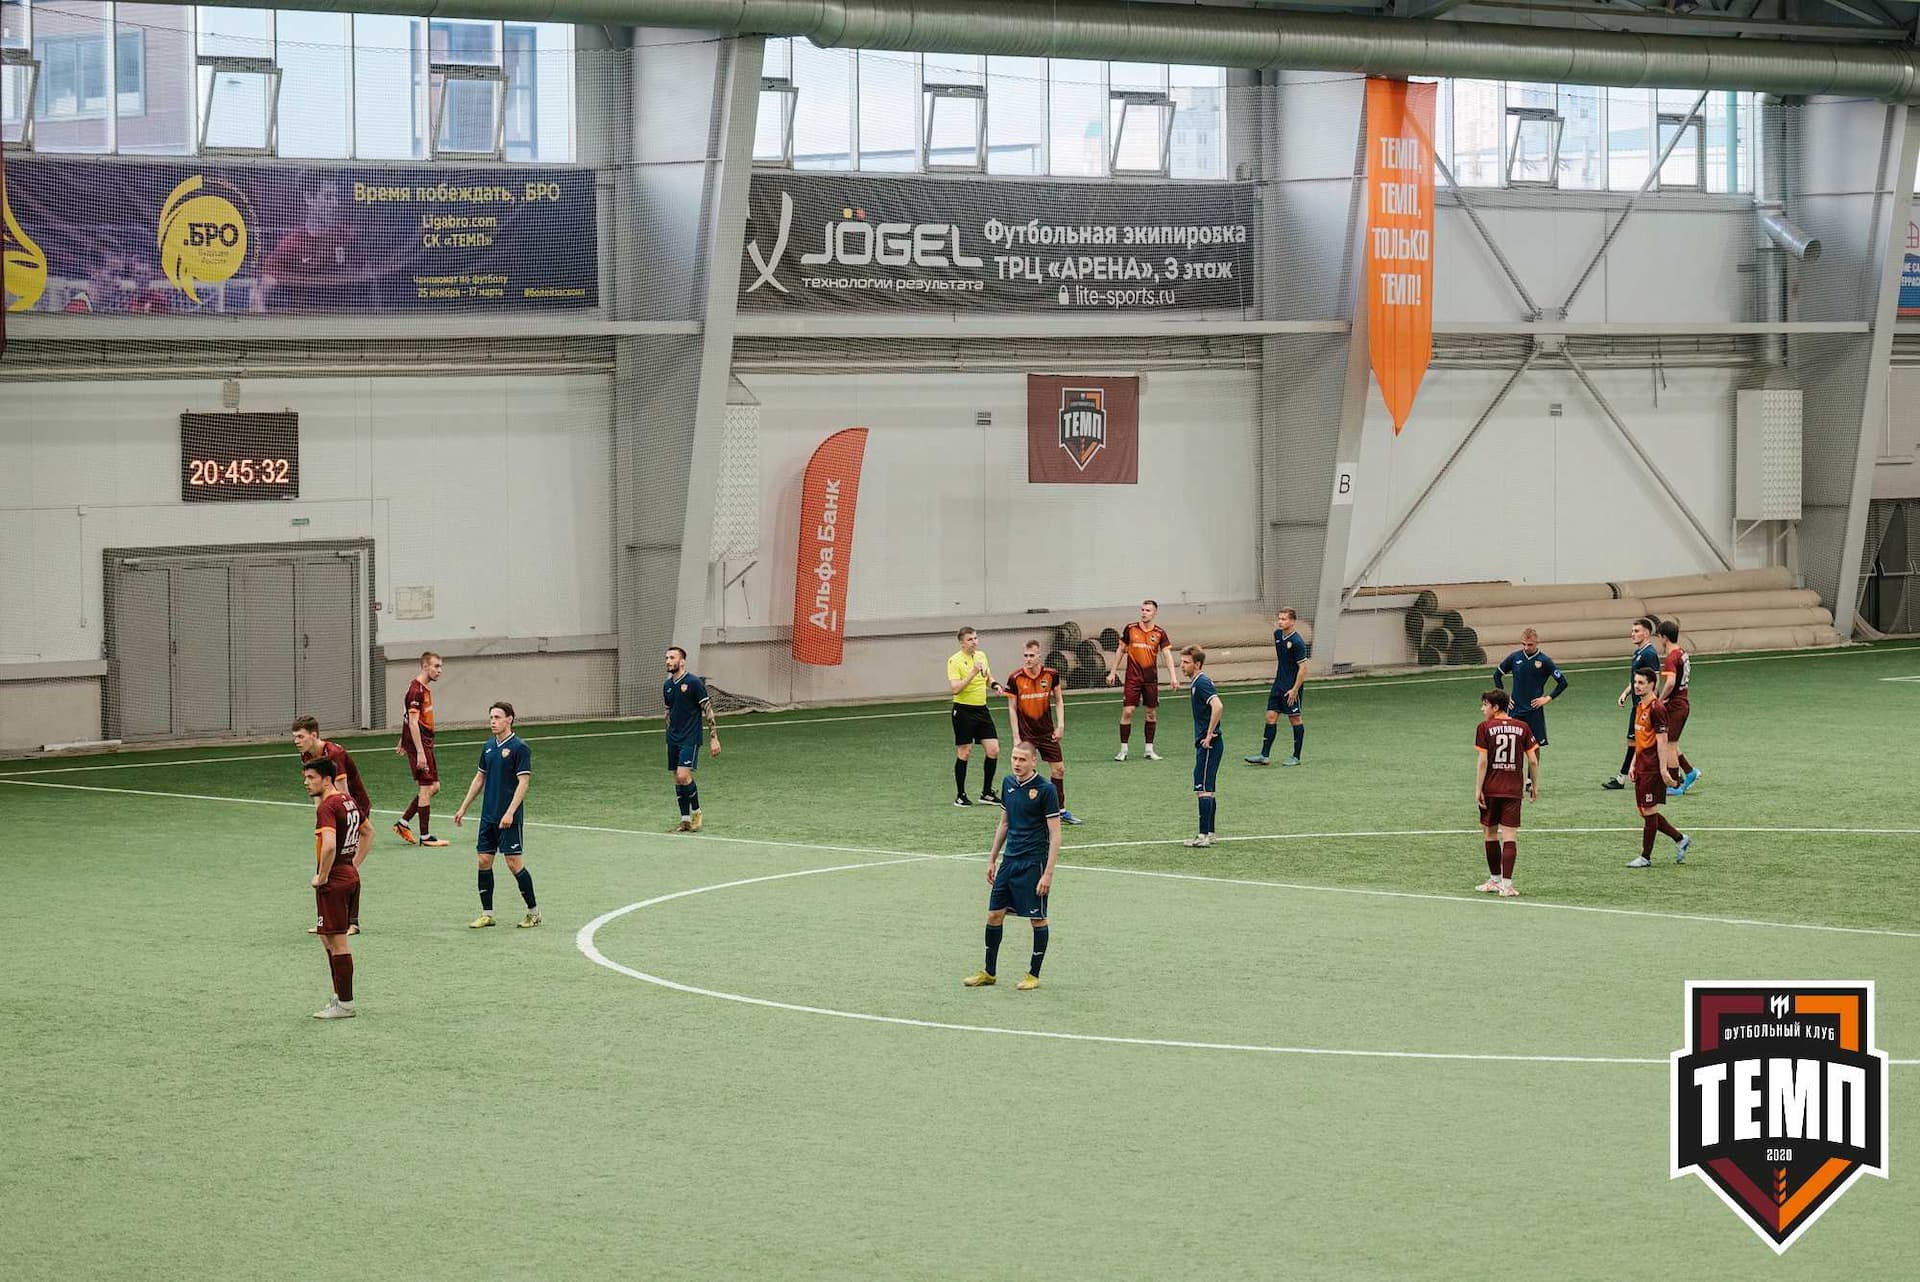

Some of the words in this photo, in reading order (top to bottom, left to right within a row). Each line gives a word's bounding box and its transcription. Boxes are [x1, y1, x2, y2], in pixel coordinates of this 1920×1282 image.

[1380, 137, 1423, 174] ТЕМП,
[355, 183, 410, 204] Время
[416, 184, 515, 203] побеждать,
[521, 183, 560, 201] .БРО
[1380, 183, 1422, 219] ТЕМП,
[183, 222, 239, 247] .БРО
[423, 214, 497, 230] Ligabro.com
[984, 218, 1117, 249] Футбольная
[1123, 224, 1246, 249] экипировка
[423, 234, 440, 247] СК
[444, 233, 493, 248] «ТЕМП»
[800, 207, 983, 267] JÖGEL
[1372, 227, 1429, 261] ТОЛЬКО
[994, 256, 1043, 284] ТРЦ
[1049, 256, 1159, 283] «АРЕНА»,
[1165, 256, 1179, 280] 3
[1182, 262, 1233, 280] этаж
[801, 277, 893, 291] технологии
[895, 278, 984, 292] результата
[1076, 286, 1176, 309] lite-sports.ru
[1380, 273, 1421, 306] ТЕМП!
[1063, 411, 1102, 439] ТЕМП
[190, 459, 289, 485] 20:45:32
[817, 478, 841, 542] Банк
[808, 547, 837, 631] Альфа
[1494, 734, 1516, 763] 21
